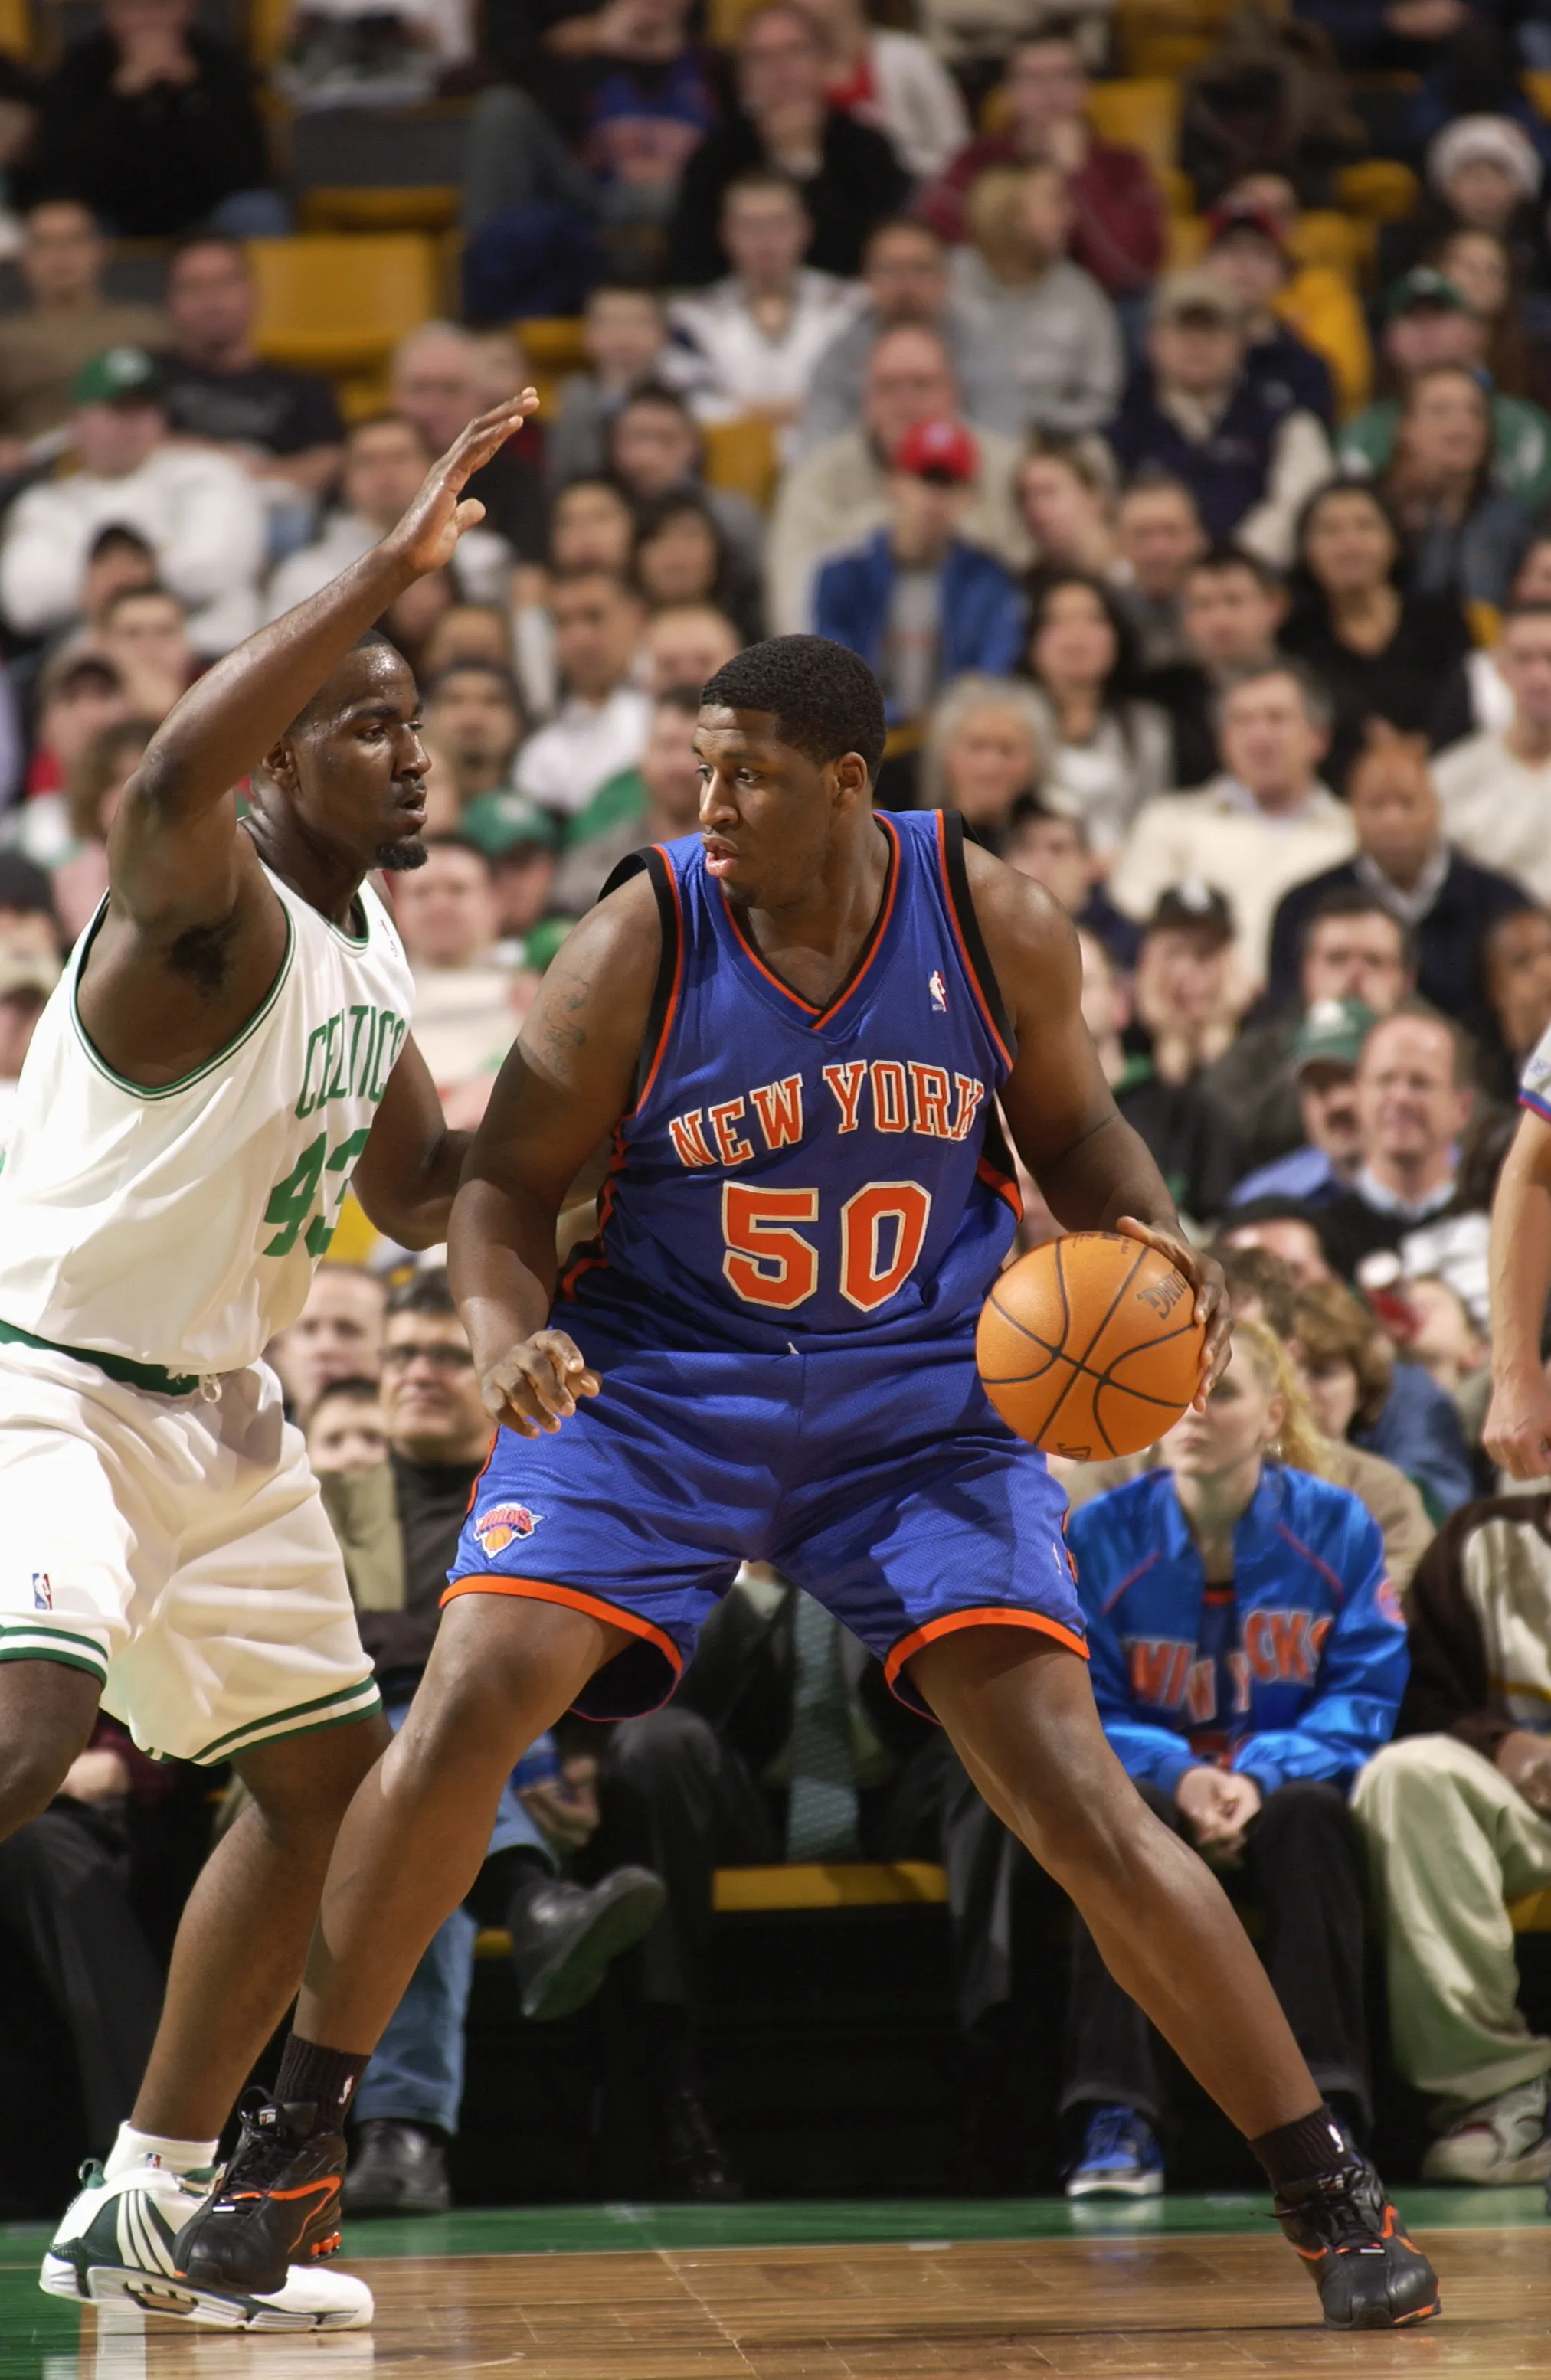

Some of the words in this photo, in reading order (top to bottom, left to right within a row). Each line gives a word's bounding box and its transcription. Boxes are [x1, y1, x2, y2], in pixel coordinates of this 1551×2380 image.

[669, 1073, 804, 1168] NEW
[823, 1059, 985, 1142] YORK
[721, 1180, 932, 1313] 50
